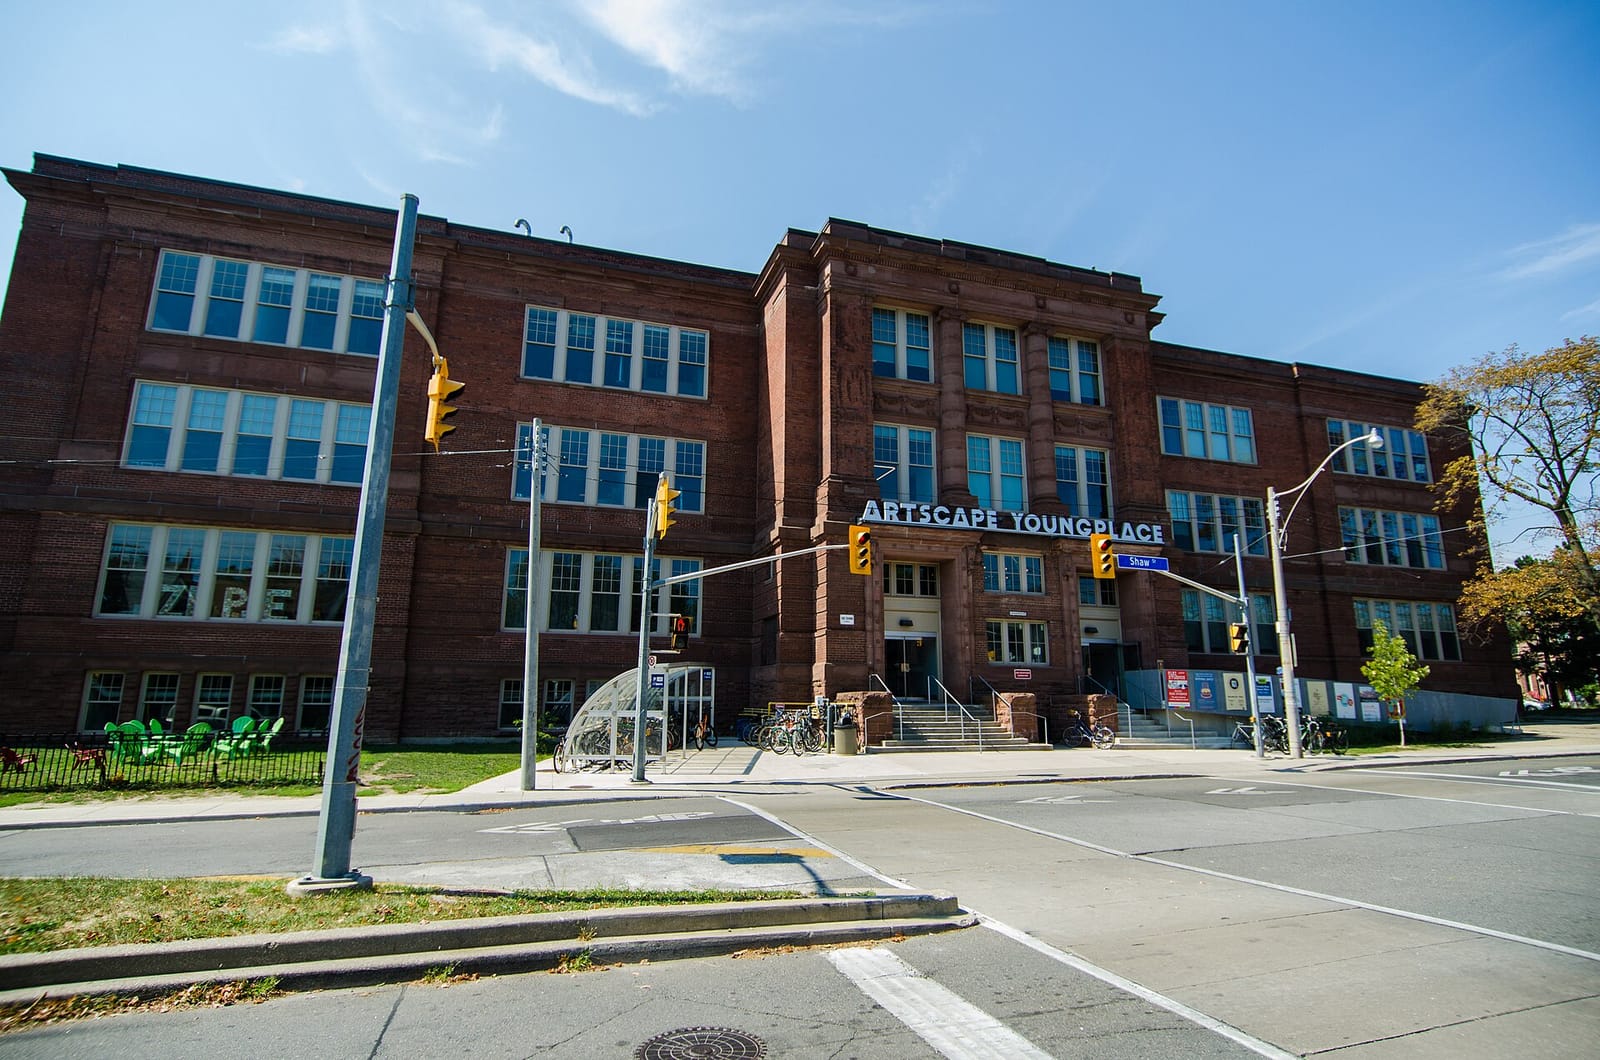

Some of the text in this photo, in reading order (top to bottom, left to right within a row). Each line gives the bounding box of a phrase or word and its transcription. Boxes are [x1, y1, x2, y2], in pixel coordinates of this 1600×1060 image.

[862, 499, 1163, 543] ARTSCAPE YOUNGPLACE
[1129, 556, 1150, 567] Shaw
